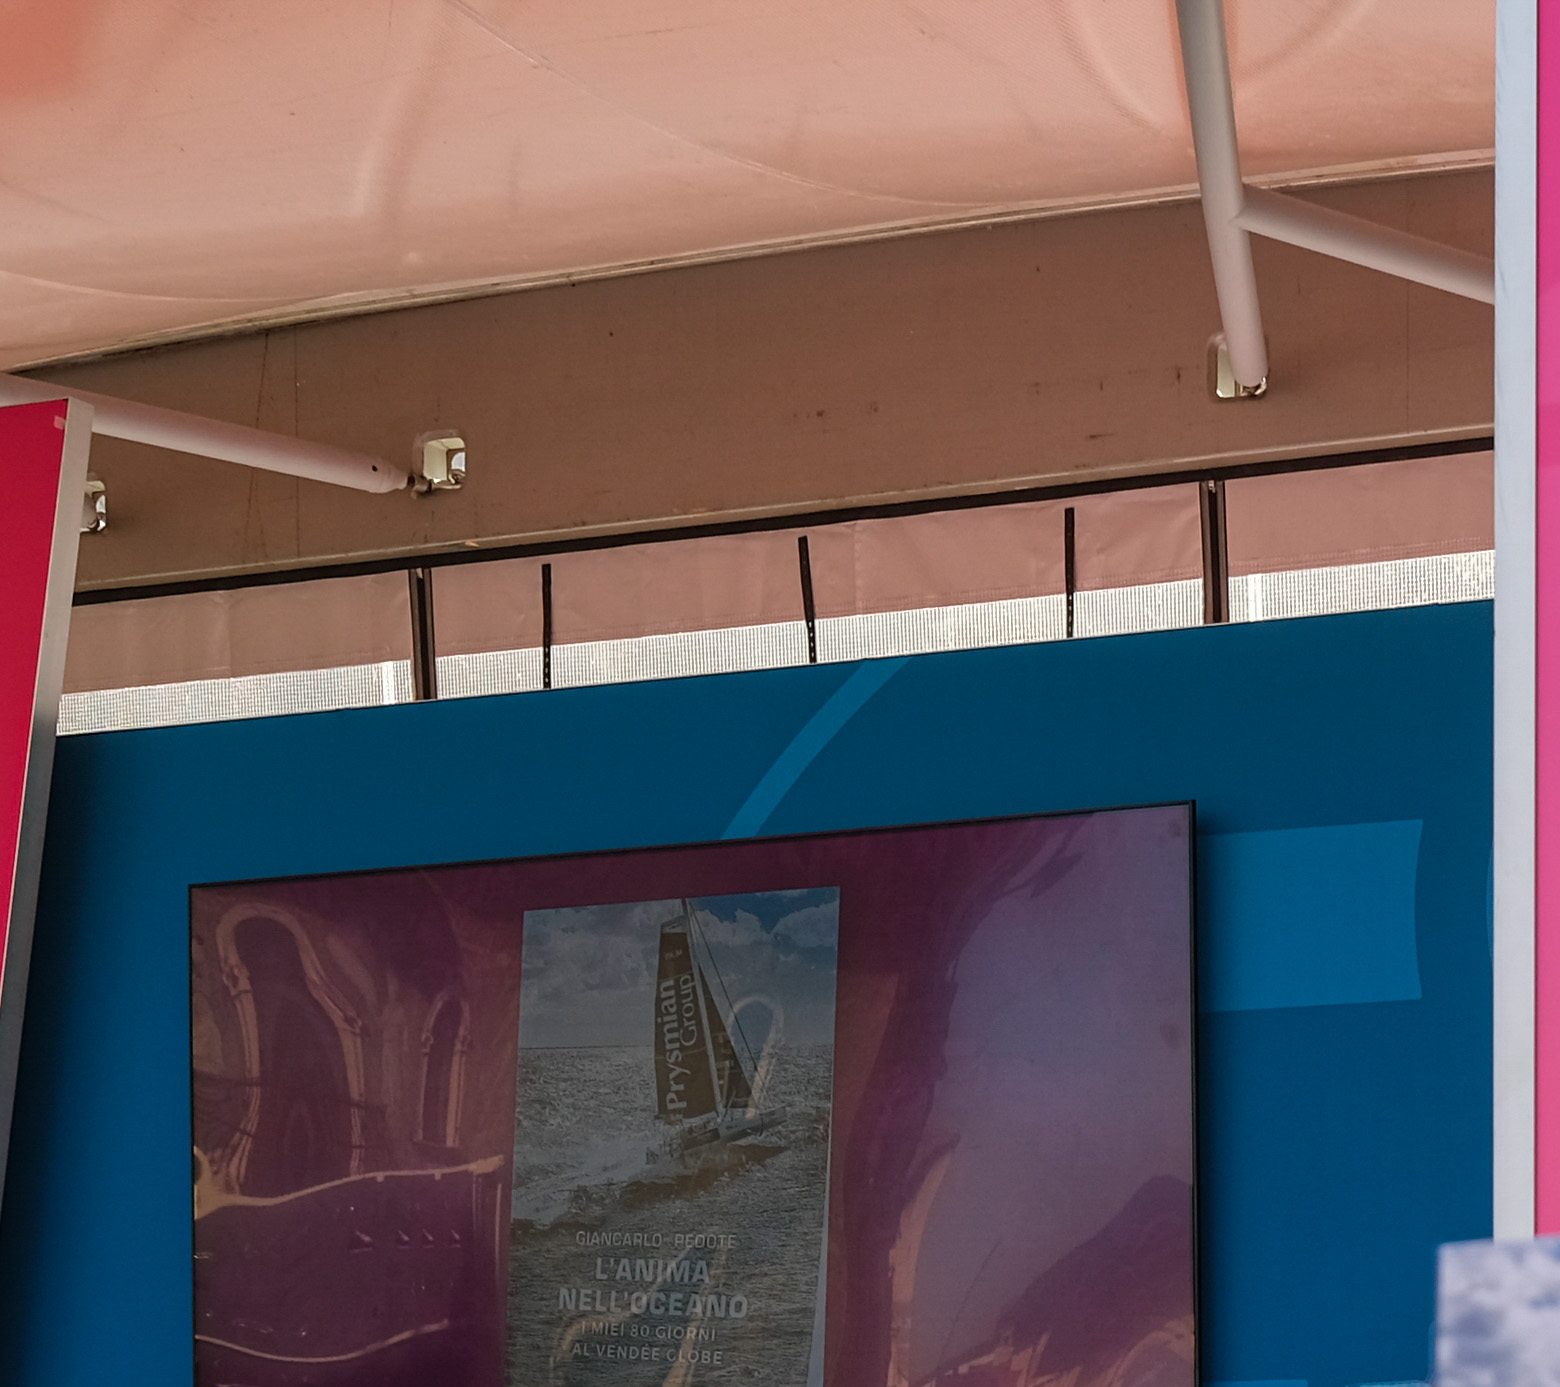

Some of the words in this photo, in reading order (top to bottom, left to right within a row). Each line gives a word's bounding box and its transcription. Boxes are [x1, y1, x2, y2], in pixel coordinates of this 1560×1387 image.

[679, 974, 697, 1047] Group
[657, 979, 691, 1110] Prysmian
[575, 1230, 663, 1248] GIANCARLO
[674, 1234, 737, 1249] PEDOTE
[595, 1257, 710, 1284] L'ANIMA
[558, 1287, 749, 1319] NELL'OCEANO
[591, 1321, 625, 1337] MIEI
[630, 1325, 650, 1338] 80
[655, 1325, 716, 1342] GIORNI
[572, 1342, 589, 1357] AL
[595, 1343, 660, 1361] VENDÉE
[666, 1348, 723, 1365] GLOBE
